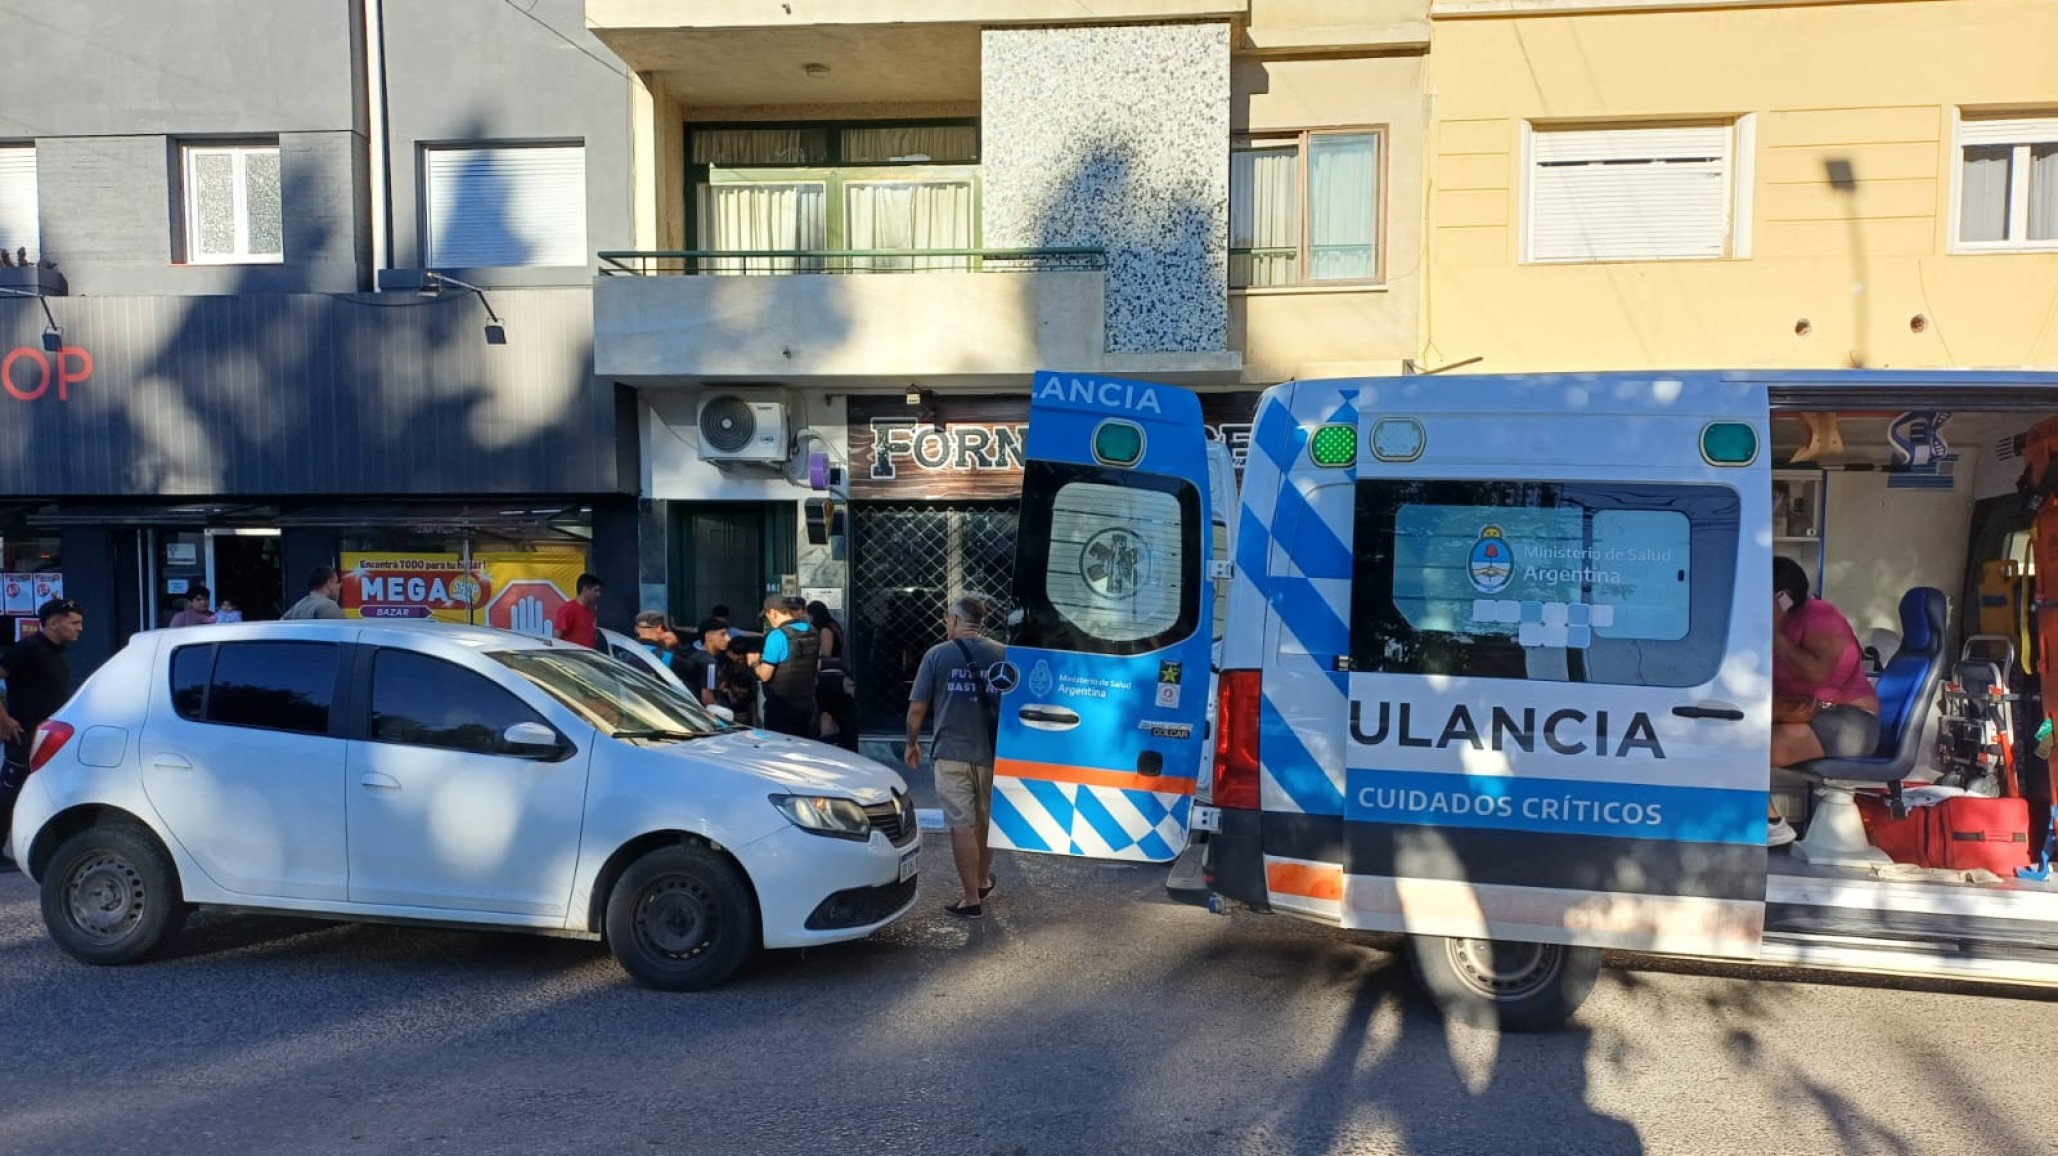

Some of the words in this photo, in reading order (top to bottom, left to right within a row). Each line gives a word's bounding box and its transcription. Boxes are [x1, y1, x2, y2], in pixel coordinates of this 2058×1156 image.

[2, 346, 93, 400] OP
[1032, 376, 1162, 414] ANCIA
[400, 560, 424, 569] TODO
[426, 562, 446, 570] para
[1524, 546, 1601, 560] Ministerio
[1605, 549, 1624, 561] de
[1628, 549, 1672, 562] Salud
[1522, 565, 1622, 585] Argentina
[361, 577, 450, 602] MEGA
[376, 608, 410, 617] BAZAR
[1058, 684, 1107, 698] Argentina
[1350, 700, 1666, 759] ULANCIA
[1359, 787, 1512, 818] CUIDADOS
[1523, 794, 1662, 825] CRÍTICOS
